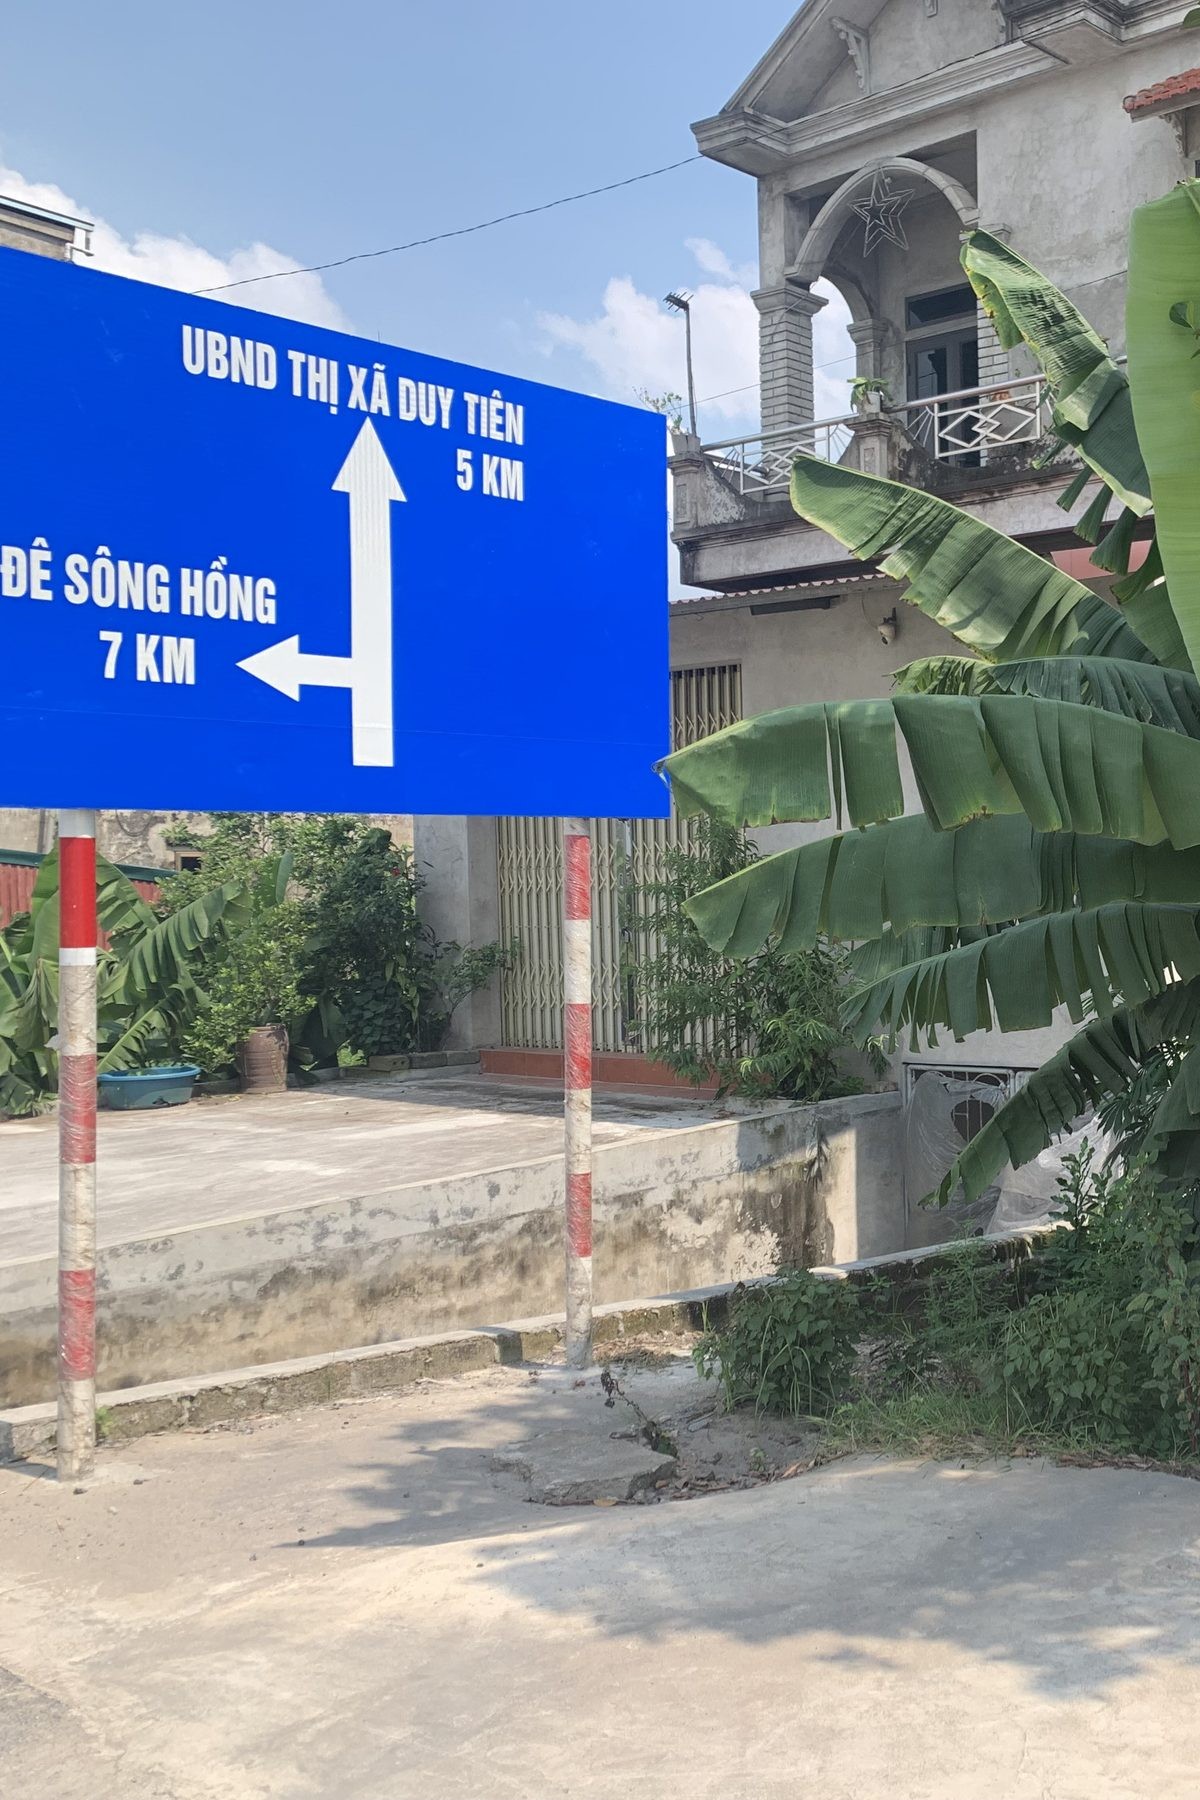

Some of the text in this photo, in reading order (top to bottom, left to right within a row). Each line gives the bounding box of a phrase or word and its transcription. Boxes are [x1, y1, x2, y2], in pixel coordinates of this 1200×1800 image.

[182, 324, 524, 446] UBND THỊ XÃ DUY TIÊN
[456, 448, 524, 502] 5 KM
[0, 536, 276, 625] ĐÊ SÔNG HỒNG
[99, 630, 196, 685] 7 KM
